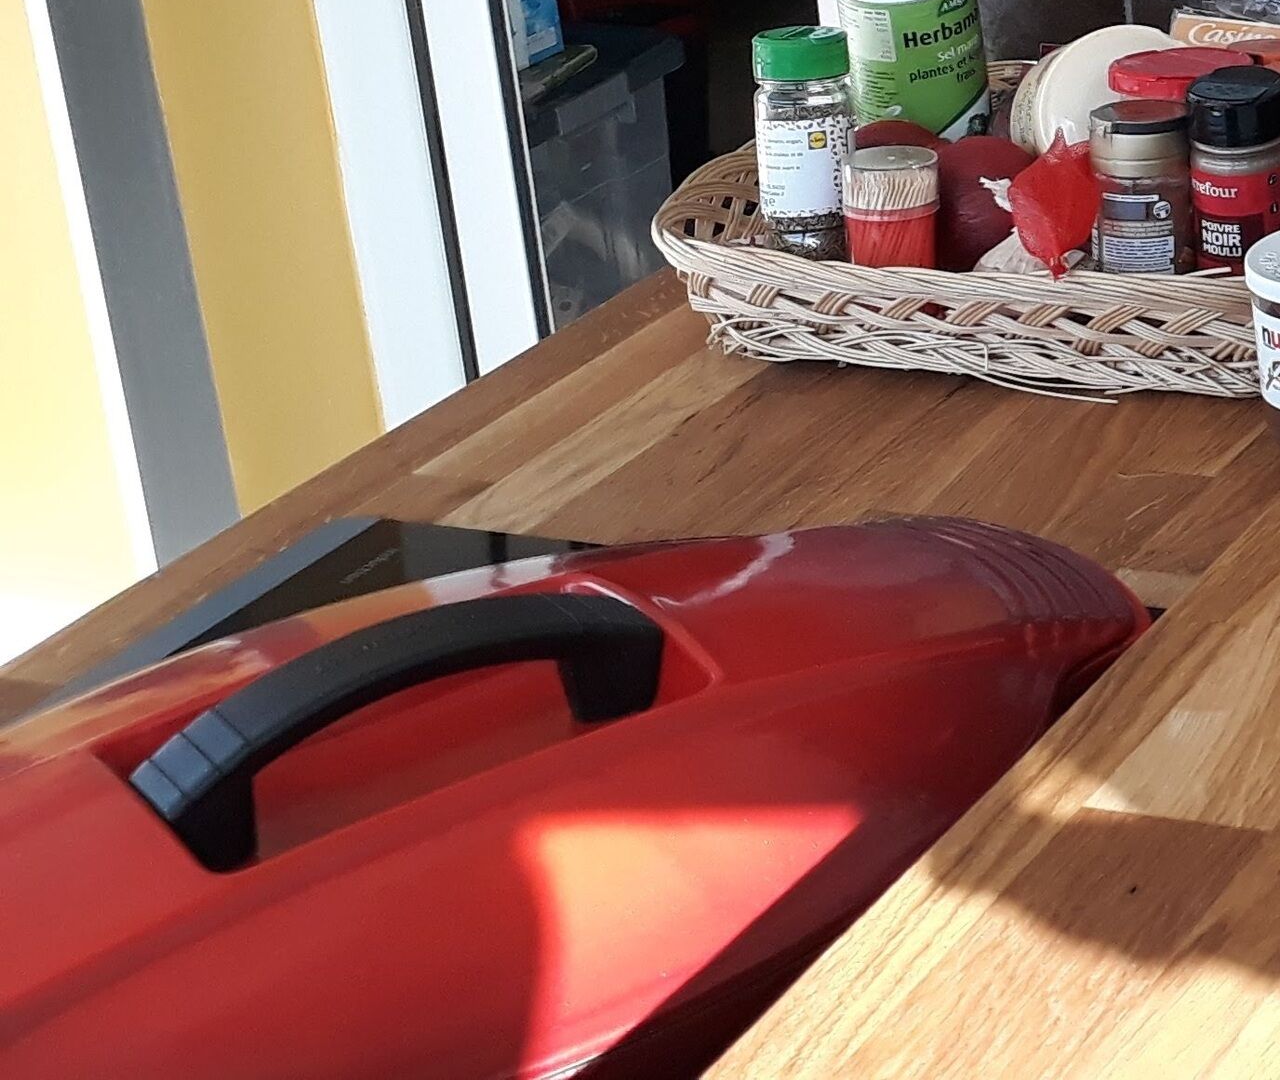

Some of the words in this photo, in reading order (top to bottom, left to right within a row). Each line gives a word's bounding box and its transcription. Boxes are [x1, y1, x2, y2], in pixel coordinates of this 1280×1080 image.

[909, 62, 955, 83] plantes
[1201, 219, 1241, 233] POIVRE
[1202, 229, 1241, 247] NOIR
[1203, 244, 1242, 257] MOULU
